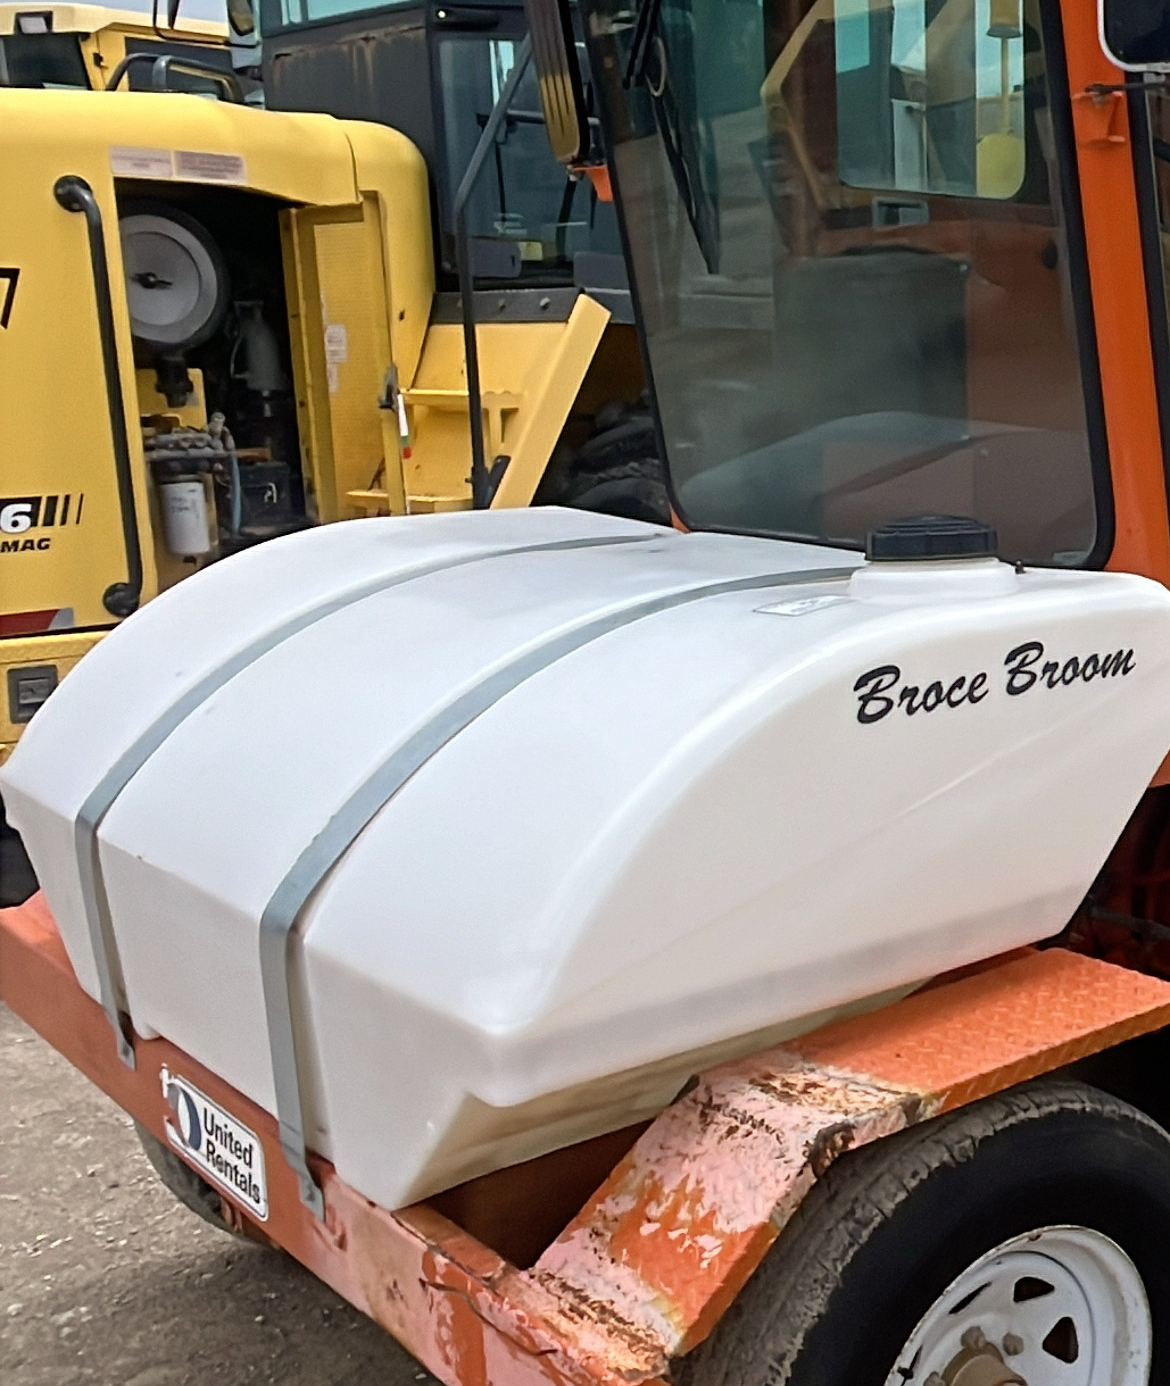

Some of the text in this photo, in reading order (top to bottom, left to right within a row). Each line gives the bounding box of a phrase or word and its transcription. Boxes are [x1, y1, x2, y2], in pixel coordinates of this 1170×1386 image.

[853, 641, 1136, 724] Broce Broom
[203, 1107, 253, 1169] United
[206, 1138, 261, 1204] Rentals
